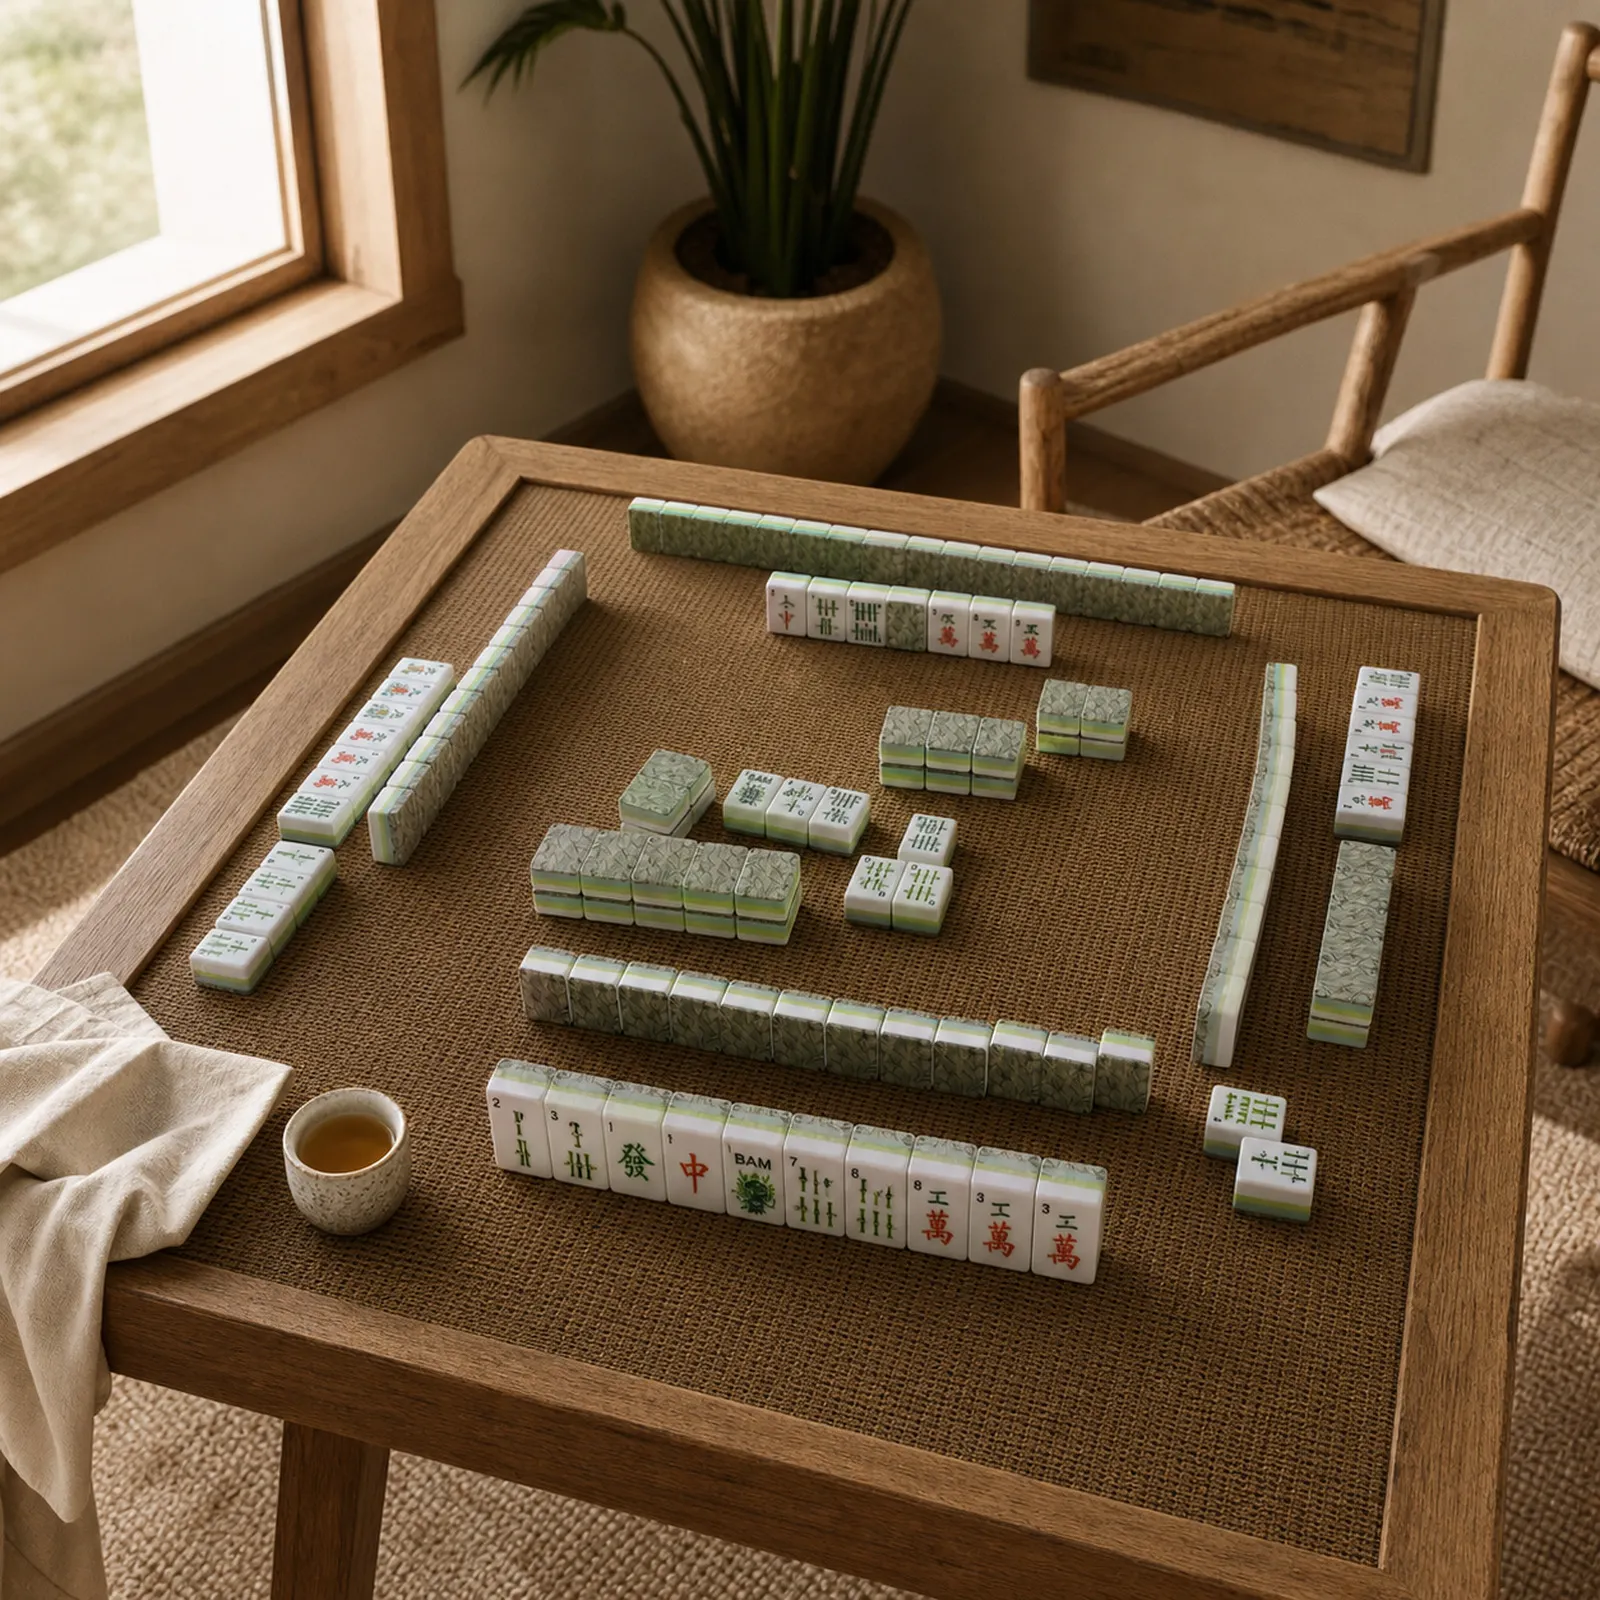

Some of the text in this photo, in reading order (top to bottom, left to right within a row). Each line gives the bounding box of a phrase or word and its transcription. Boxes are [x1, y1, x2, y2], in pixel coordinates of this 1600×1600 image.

[492, 1097, 501, 1109] 2
[550, 1110, 559, 1121] 3
[618, 1142, 656, 1182] 發
[734, 1152, 772, 1171] BAM
[789, 1156, 798, 1168] 7
[679, 1152, 710, 1194] 中
[851, 1168, 860, 1179] 8
[913, 1180, 922, 1191] 8
[976, 1192, 985, 1203] 3
[1041, 1203, 1051, 1215] 3
